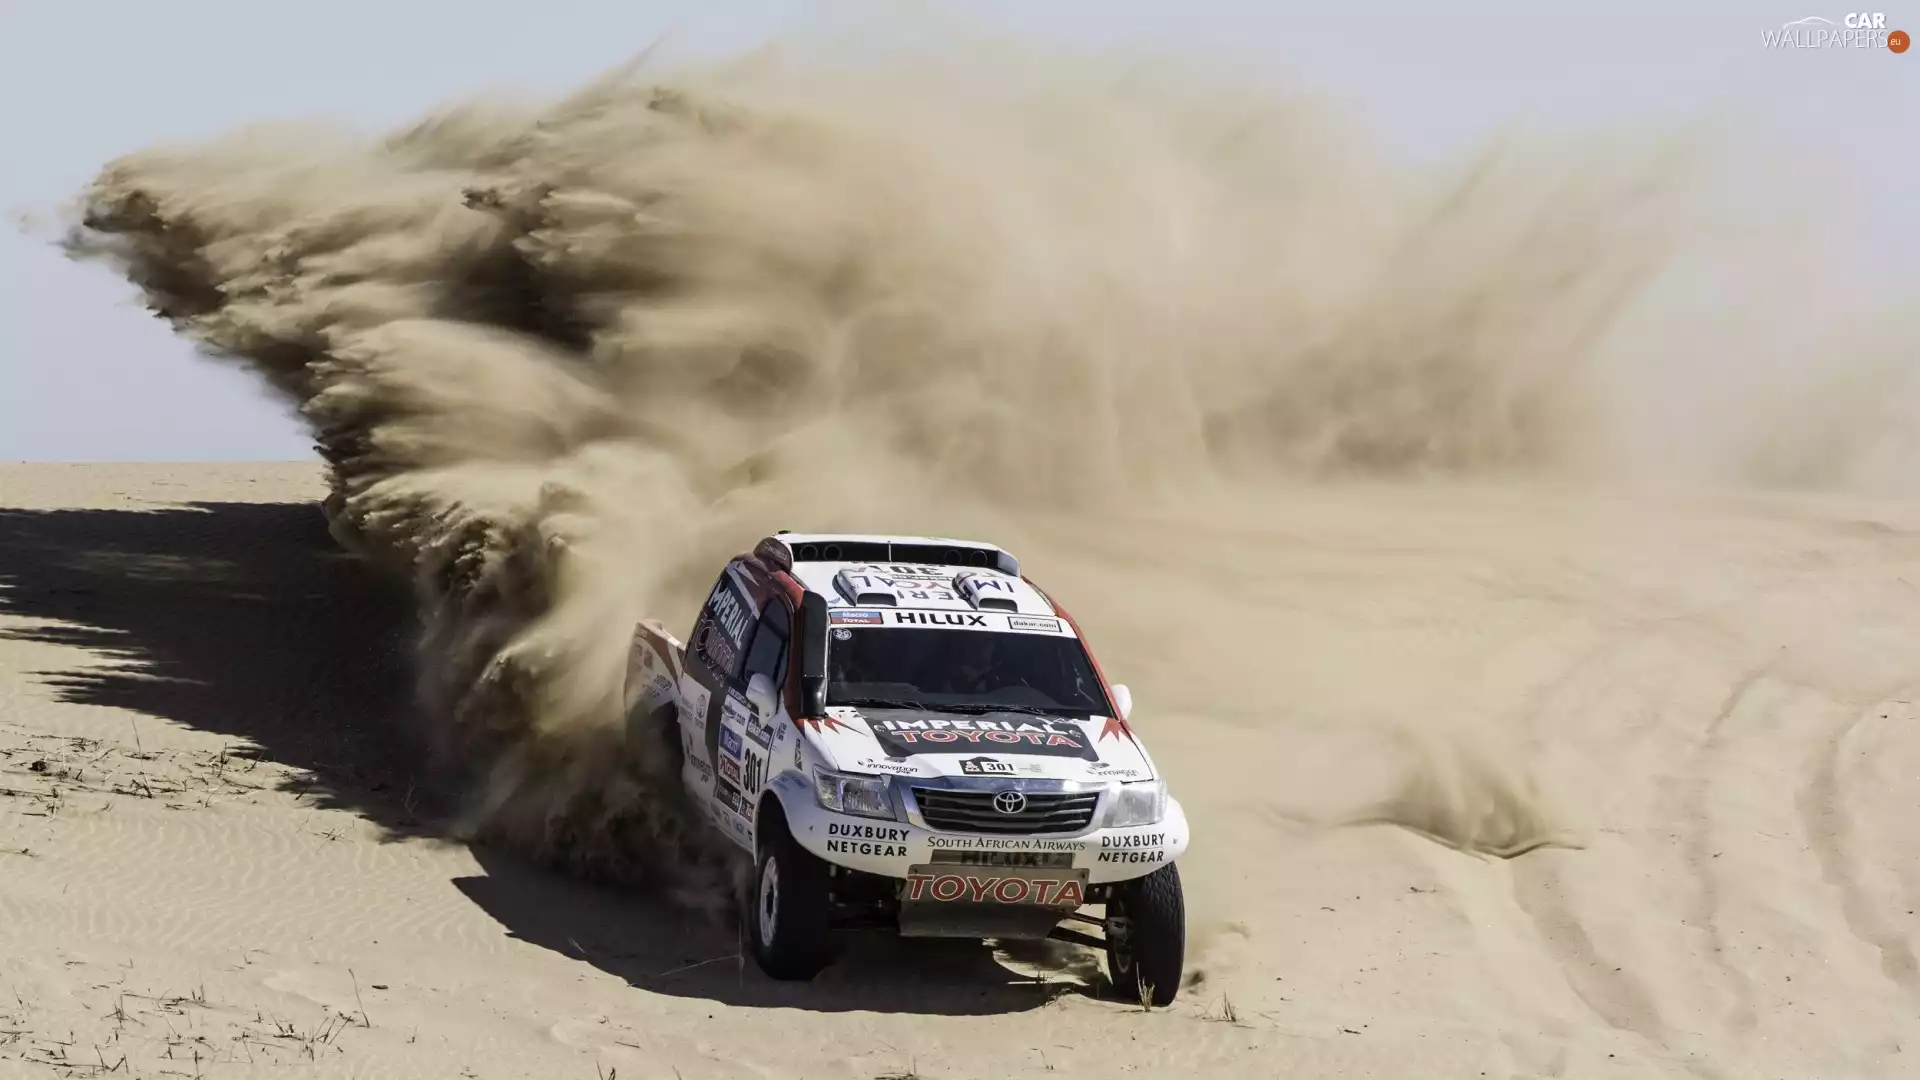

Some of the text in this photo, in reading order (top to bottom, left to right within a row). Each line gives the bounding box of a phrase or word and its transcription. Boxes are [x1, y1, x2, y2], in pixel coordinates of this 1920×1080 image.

[708, 582, 749, 650] MPERIAL
[895, 612, 988, 628] HILUX
[882, 720, 1069, 736] IMPERIAL
[891, 729, 1084, 749] TOYOTA
[743, 747, 762, 794] 301
[866, 762, 918, 774] innovation
[986, 762, 1015, 773] 301
[828, 823, 910, 842] DUXBURY
[1101, 833, 1166, 848] DUXBURY
[827, 839, 907, 857] NETGEAR
[927, 836, 1086, 852] SOUTH AFRICAN AIRWAYS
[1098, 850, 1165, 864] NETGEAR
[907, 873, 1084, 906] TOYOTA
